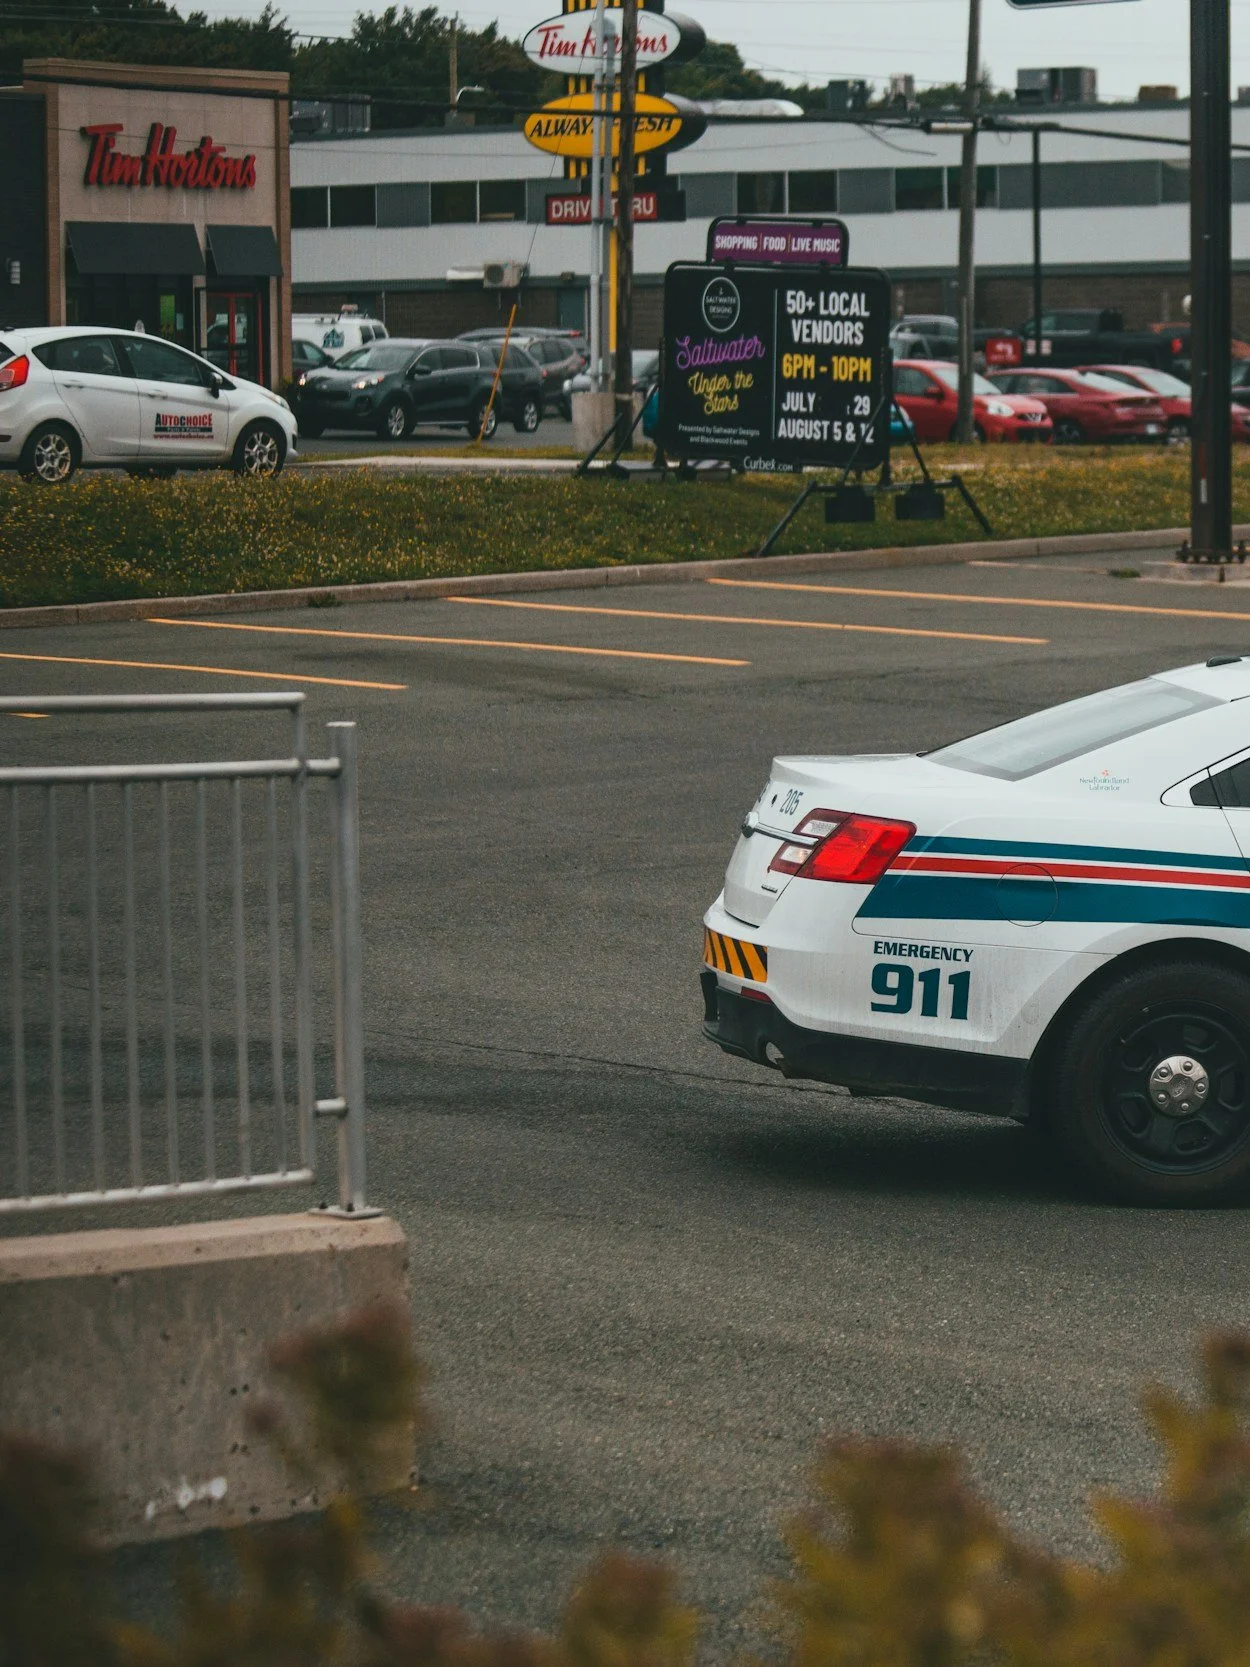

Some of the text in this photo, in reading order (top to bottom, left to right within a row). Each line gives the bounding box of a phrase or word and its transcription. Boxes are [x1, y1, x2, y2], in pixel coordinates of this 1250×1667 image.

[538, 24, 577, 59] Tim
[529, 117, 600, 138] ALWAY
[80, 122, 256, 189] Tim Hortons
[551, 199, 598, 218] DRIV
[715, 235, 840, 253] SHOPPING FOOD LIVE MUSIC
[786, 290, 870, 317] 50+ LOCAL
[791, 319, 864, 346] VENDORS
[676, 334, 766, 369] Saltwater
[782, 353, 815, 379] 6PM
[832, 355, 872, 382] 10PM
[688, 370, 755, 395] Under the
[703, 394, 739, 415] Stars
[781, 392, 870, 416] JULY 29
[778, 418, 830, 441] AUGUST
[832, 421, 842, 441] 5
[845, 422, 856, 443] &
[780, 788, 804, 815] 205
[873, 940, 974, 963] EMERGENCY
[870, 963, 971, 1020] 911
